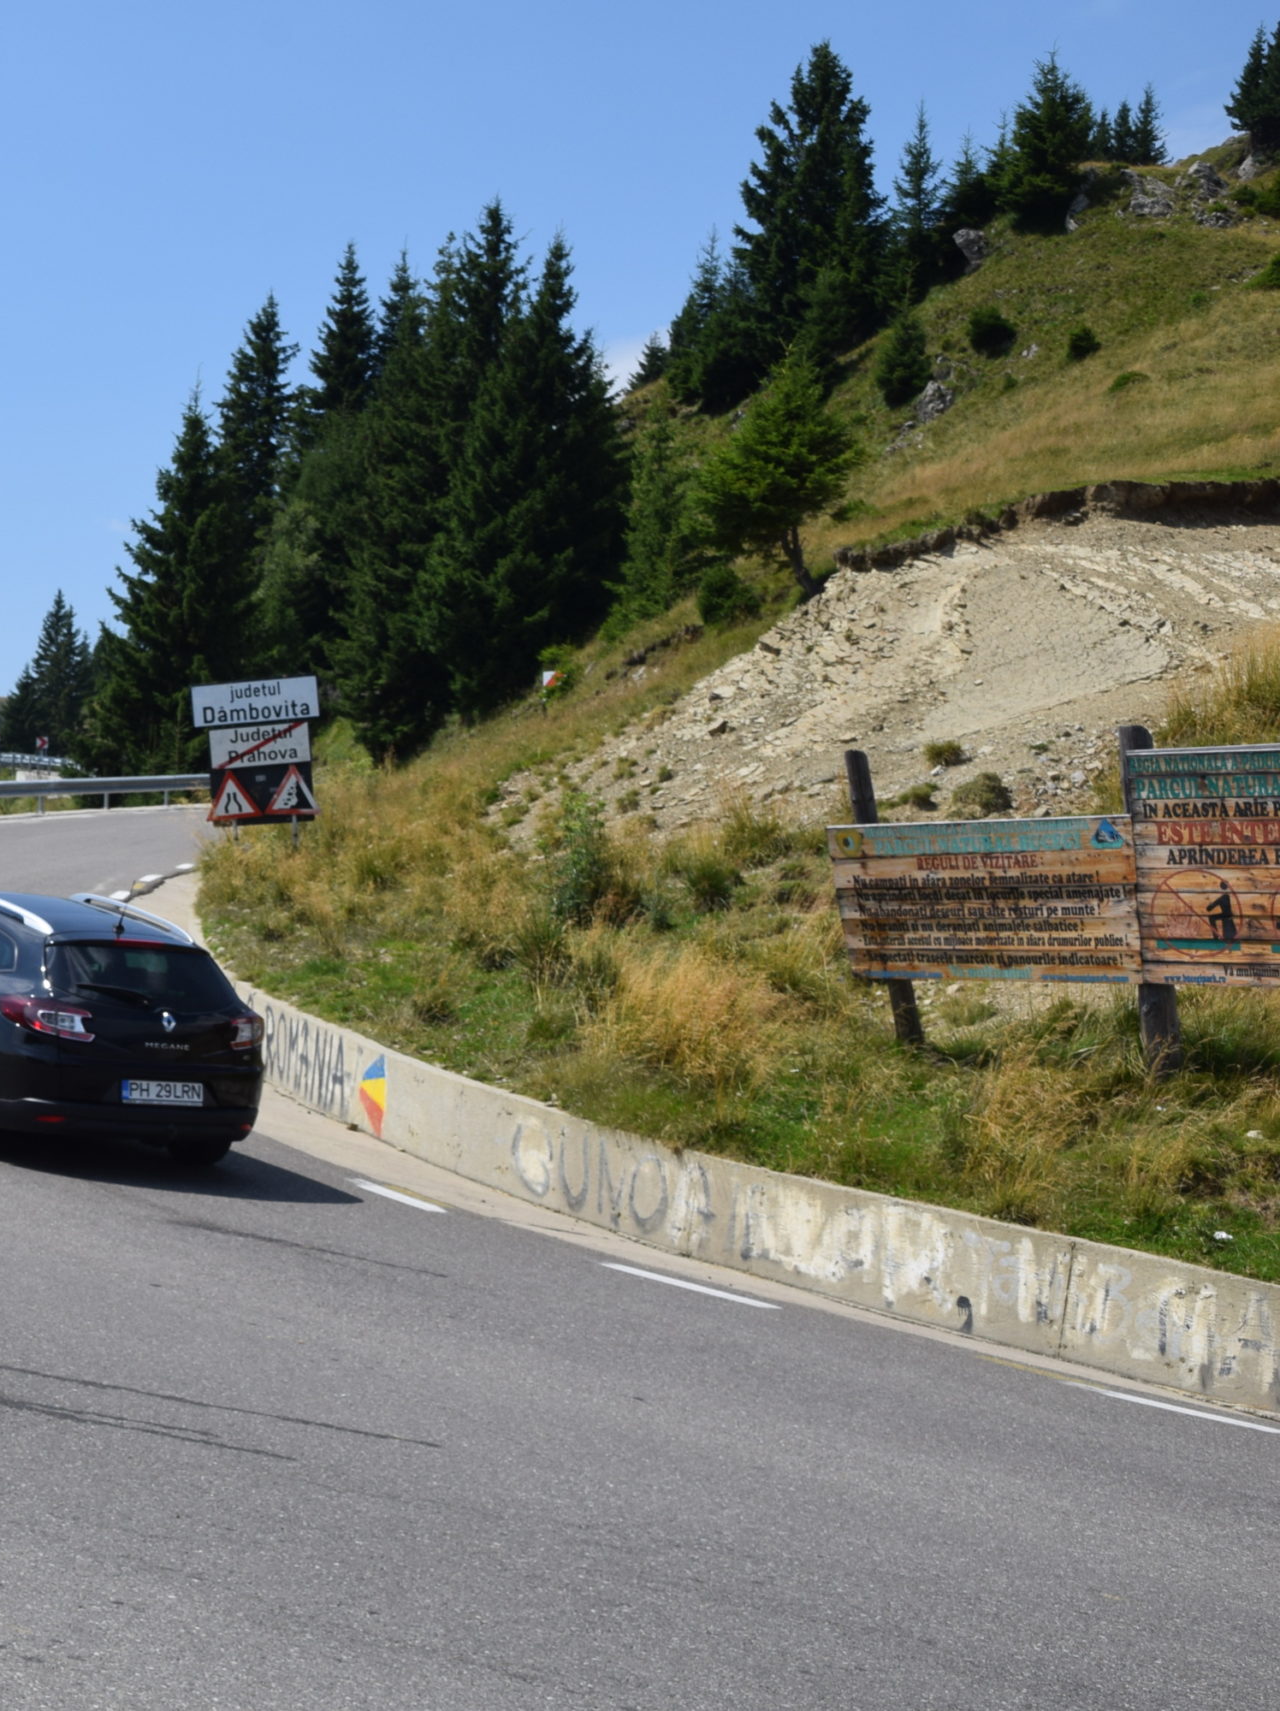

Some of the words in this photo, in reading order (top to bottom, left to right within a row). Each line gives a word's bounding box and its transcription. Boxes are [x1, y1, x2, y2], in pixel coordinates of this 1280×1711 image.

[228, 747, 298, 764] Prahova
[1135, 776, 1202, 800] PARCUL
[1156, 821, 1212, 846] ESTE
[916, 855, 959, 871] REGULI
[962, 854, 979, 870] DE
[128, 1082, 150, 1098] PH
